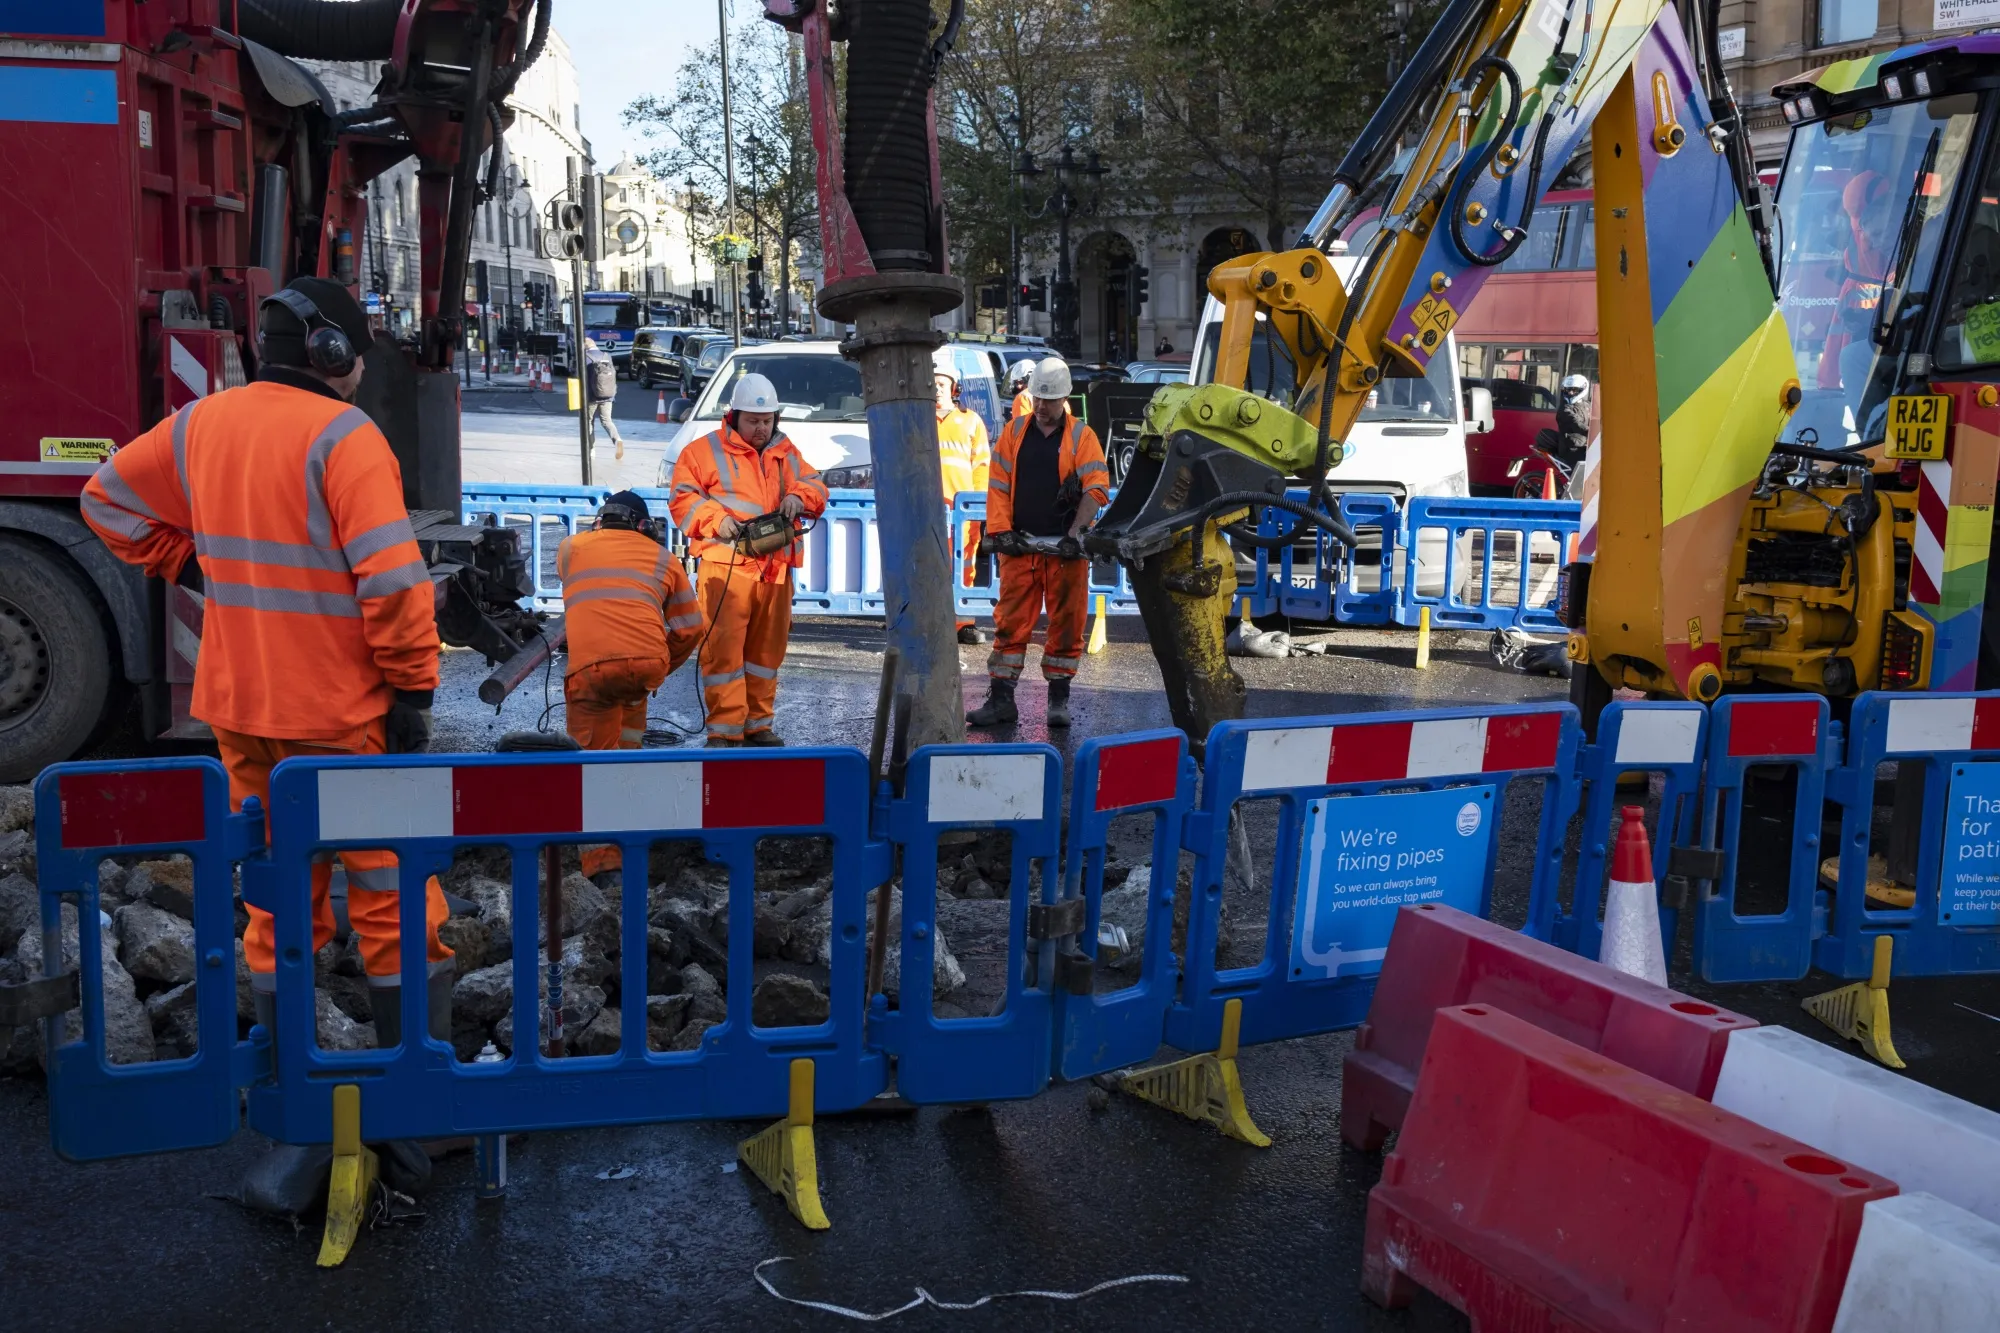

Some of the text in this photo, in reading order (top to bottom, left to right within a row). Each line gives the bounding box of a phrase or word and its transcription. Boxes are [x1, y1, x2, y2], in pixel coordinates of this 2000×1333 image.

[1940, 0, 1999, 9] WHITEHA
[1940, 10, 1960, 19] SW1
[1790, 296, 1841, 308] Stagecoac
[1896, 399, 1938, 423] RA21
[1896, 428, 1933, 452] HJG
[1961, 817, 1992, 836] for
[1338, 847, 1445, 872] fixing pipes
[1959, 840, 2000, 861] pati
[1334, 875, 1437, 894] So we can always bring
[1956, 874, 2000, 883] While we
[1332, 889, 1444, 912] you world-class tap water
[1954, 888, 1977, 899] keep
[1953, 902, 1963, 911] at
[1966, 901, 1988, 910] their
